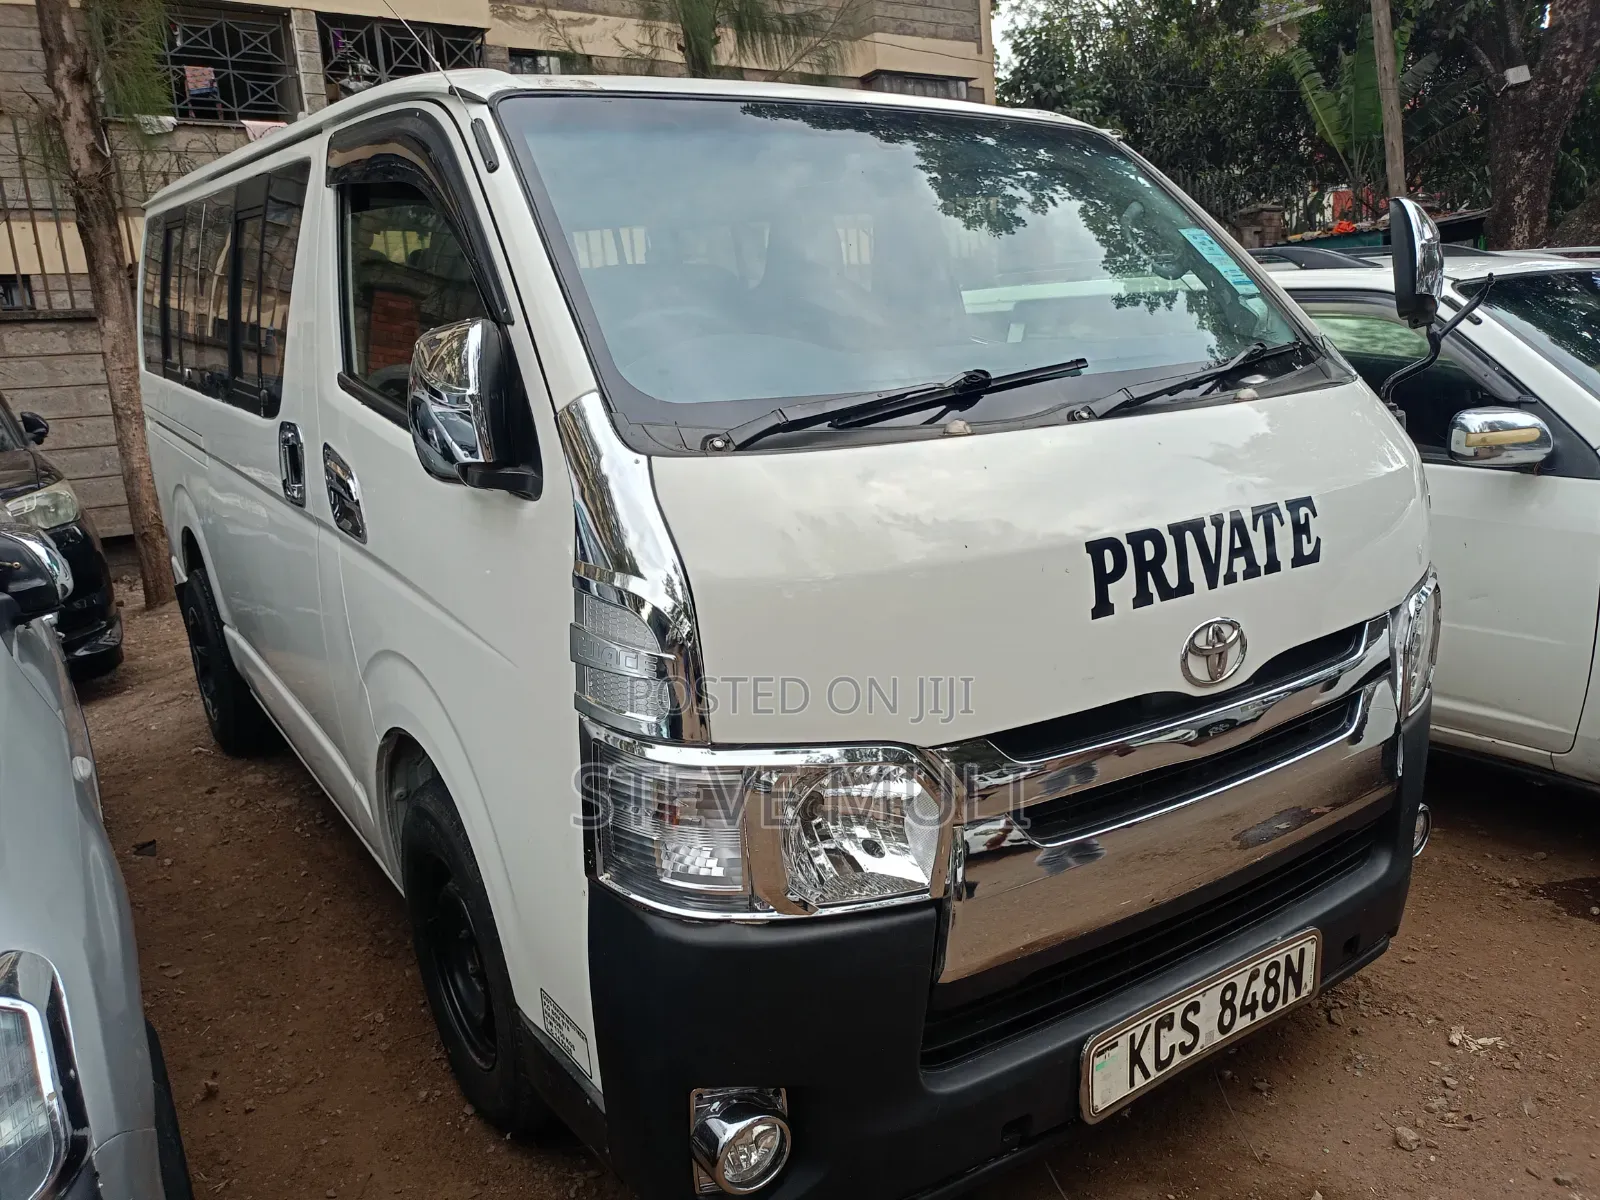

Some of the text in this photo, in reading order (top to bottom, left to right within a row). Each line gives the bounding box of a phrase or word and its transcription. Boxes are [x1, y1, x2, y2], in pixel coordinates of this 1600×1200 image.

[1085, 495, 1322, 620] PRIVATE
[577, 636, 657, 678] HIACE
[1128, 947, 1306, 1089] KCS 848N
